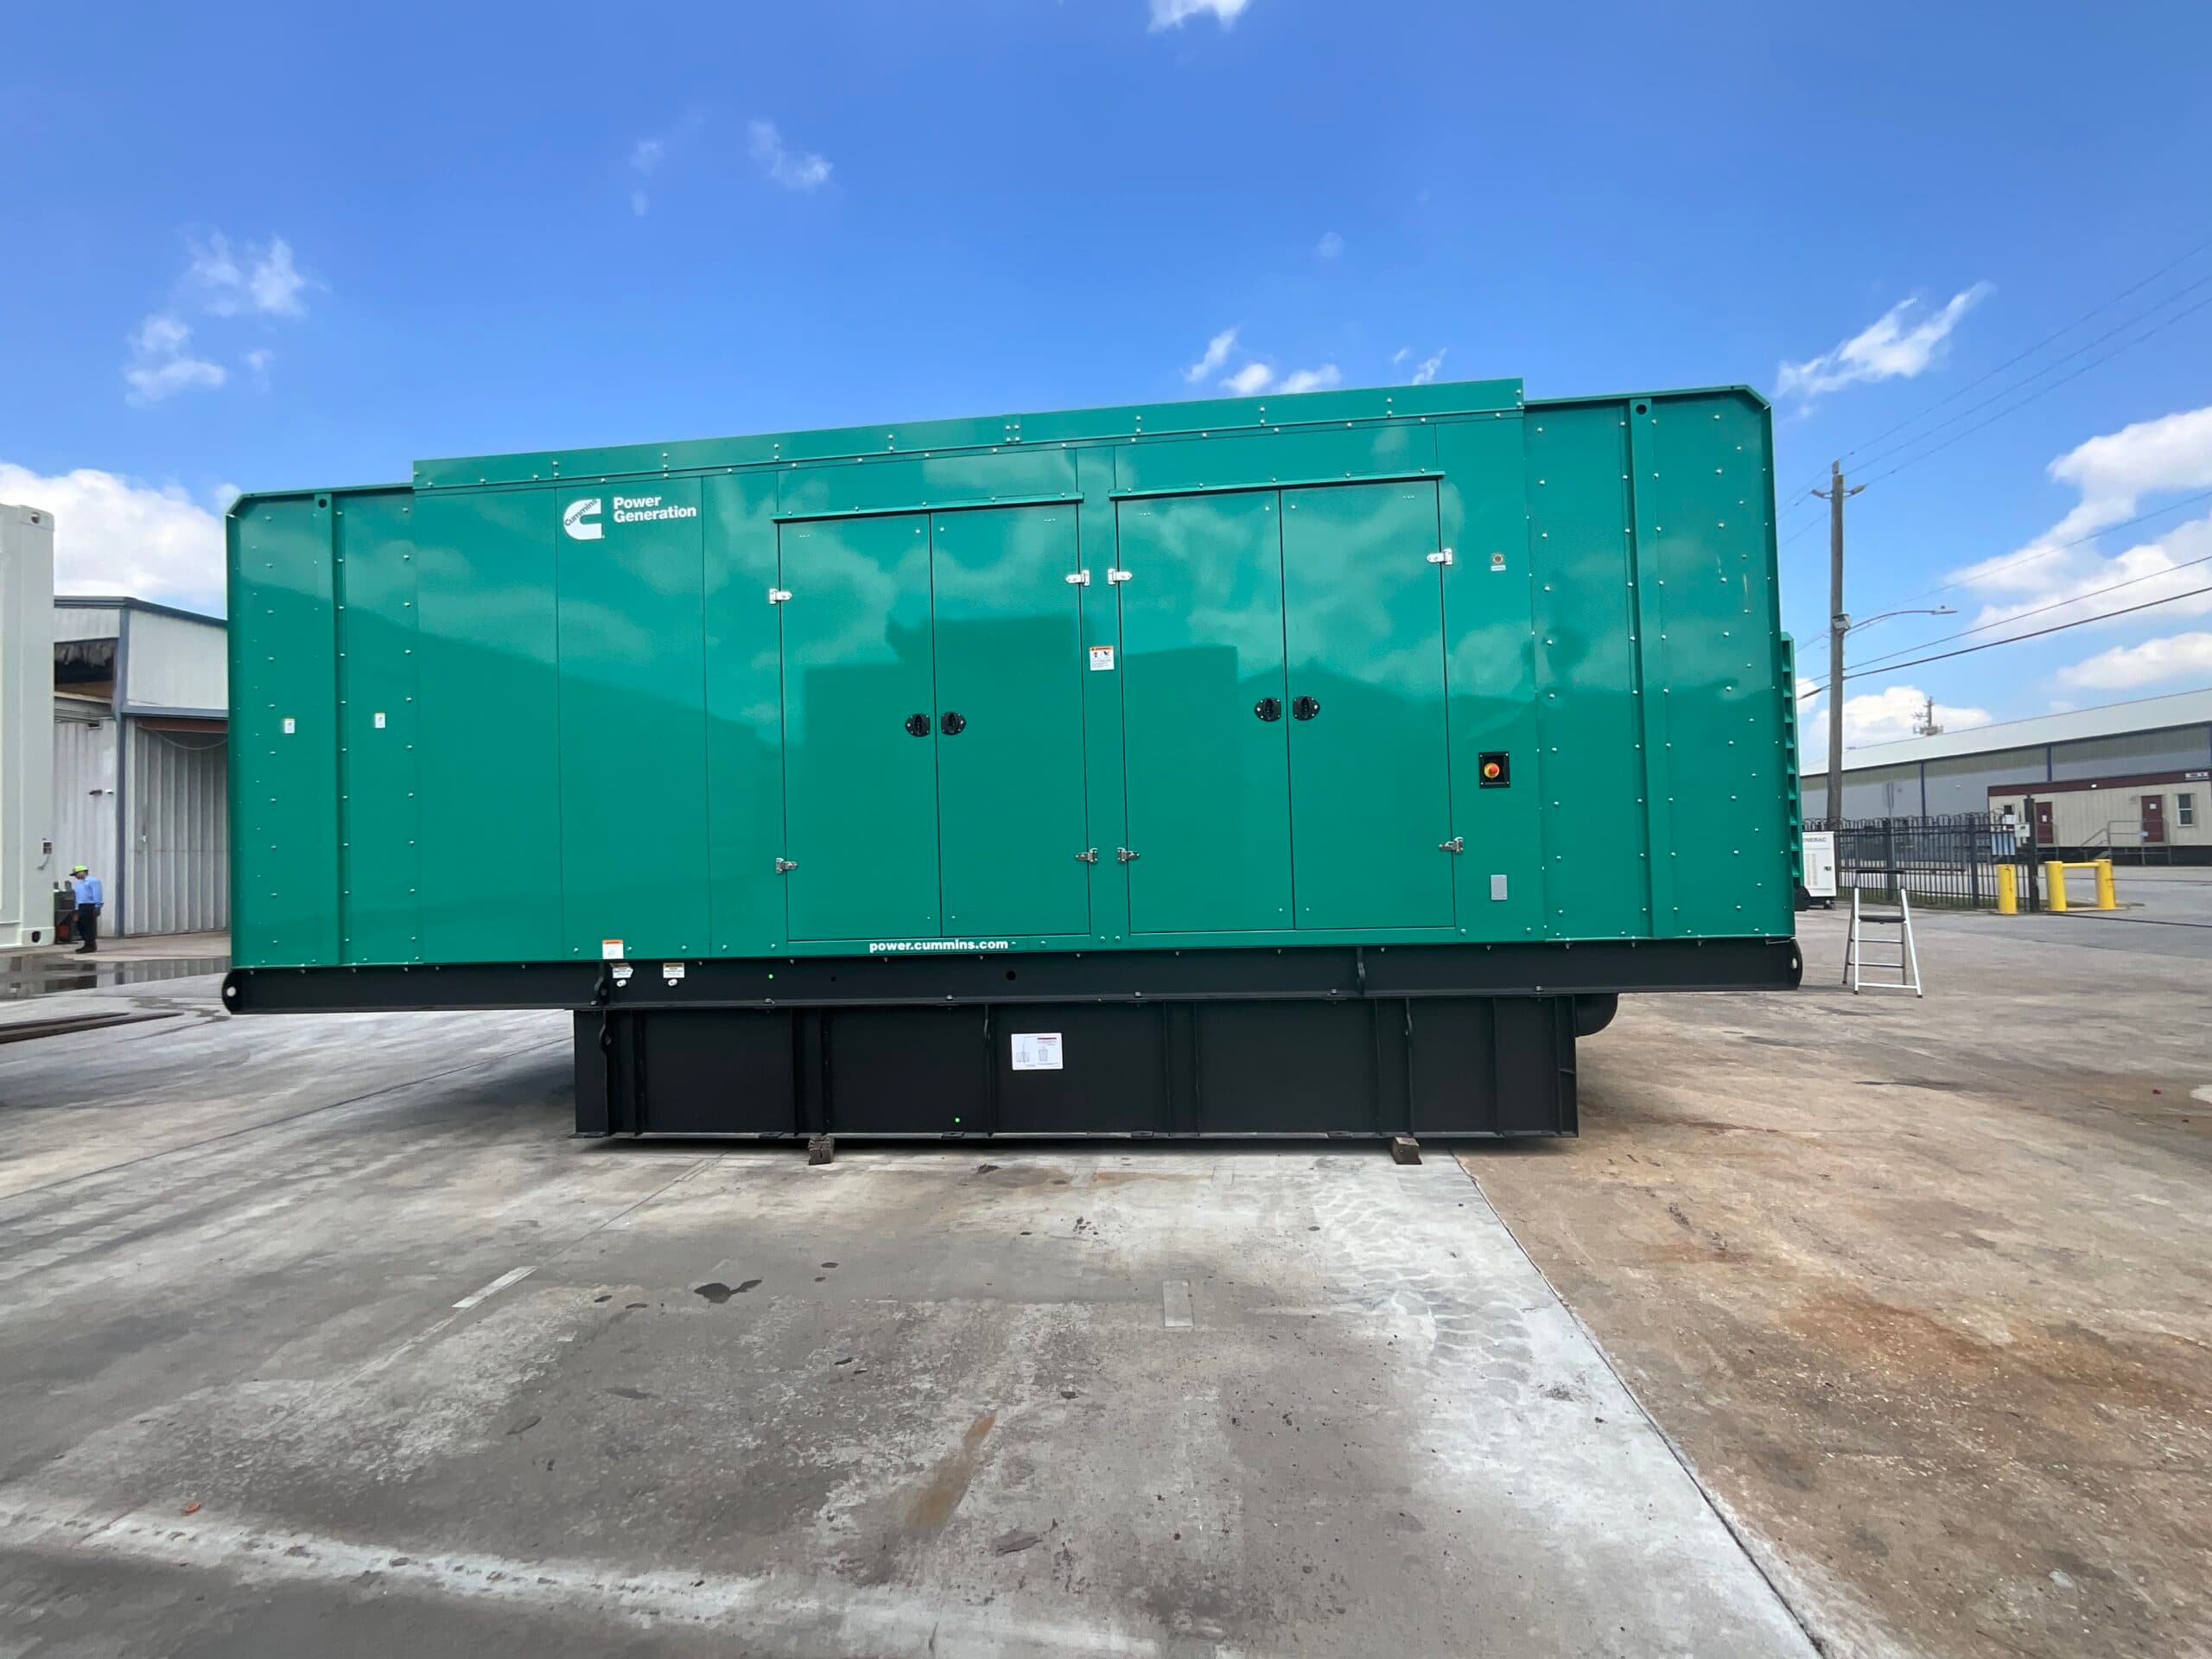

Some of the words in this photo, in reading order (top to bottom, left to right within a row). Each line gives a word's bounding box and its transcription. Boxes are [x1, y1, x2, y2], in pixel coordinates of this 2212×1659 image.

[613, 497, 661, 510] Power
[564, 499, 598, 526] Cummins
[613, 505, 697, 523] Generation
[869, 939, 1008, 953] power.cummins.com
